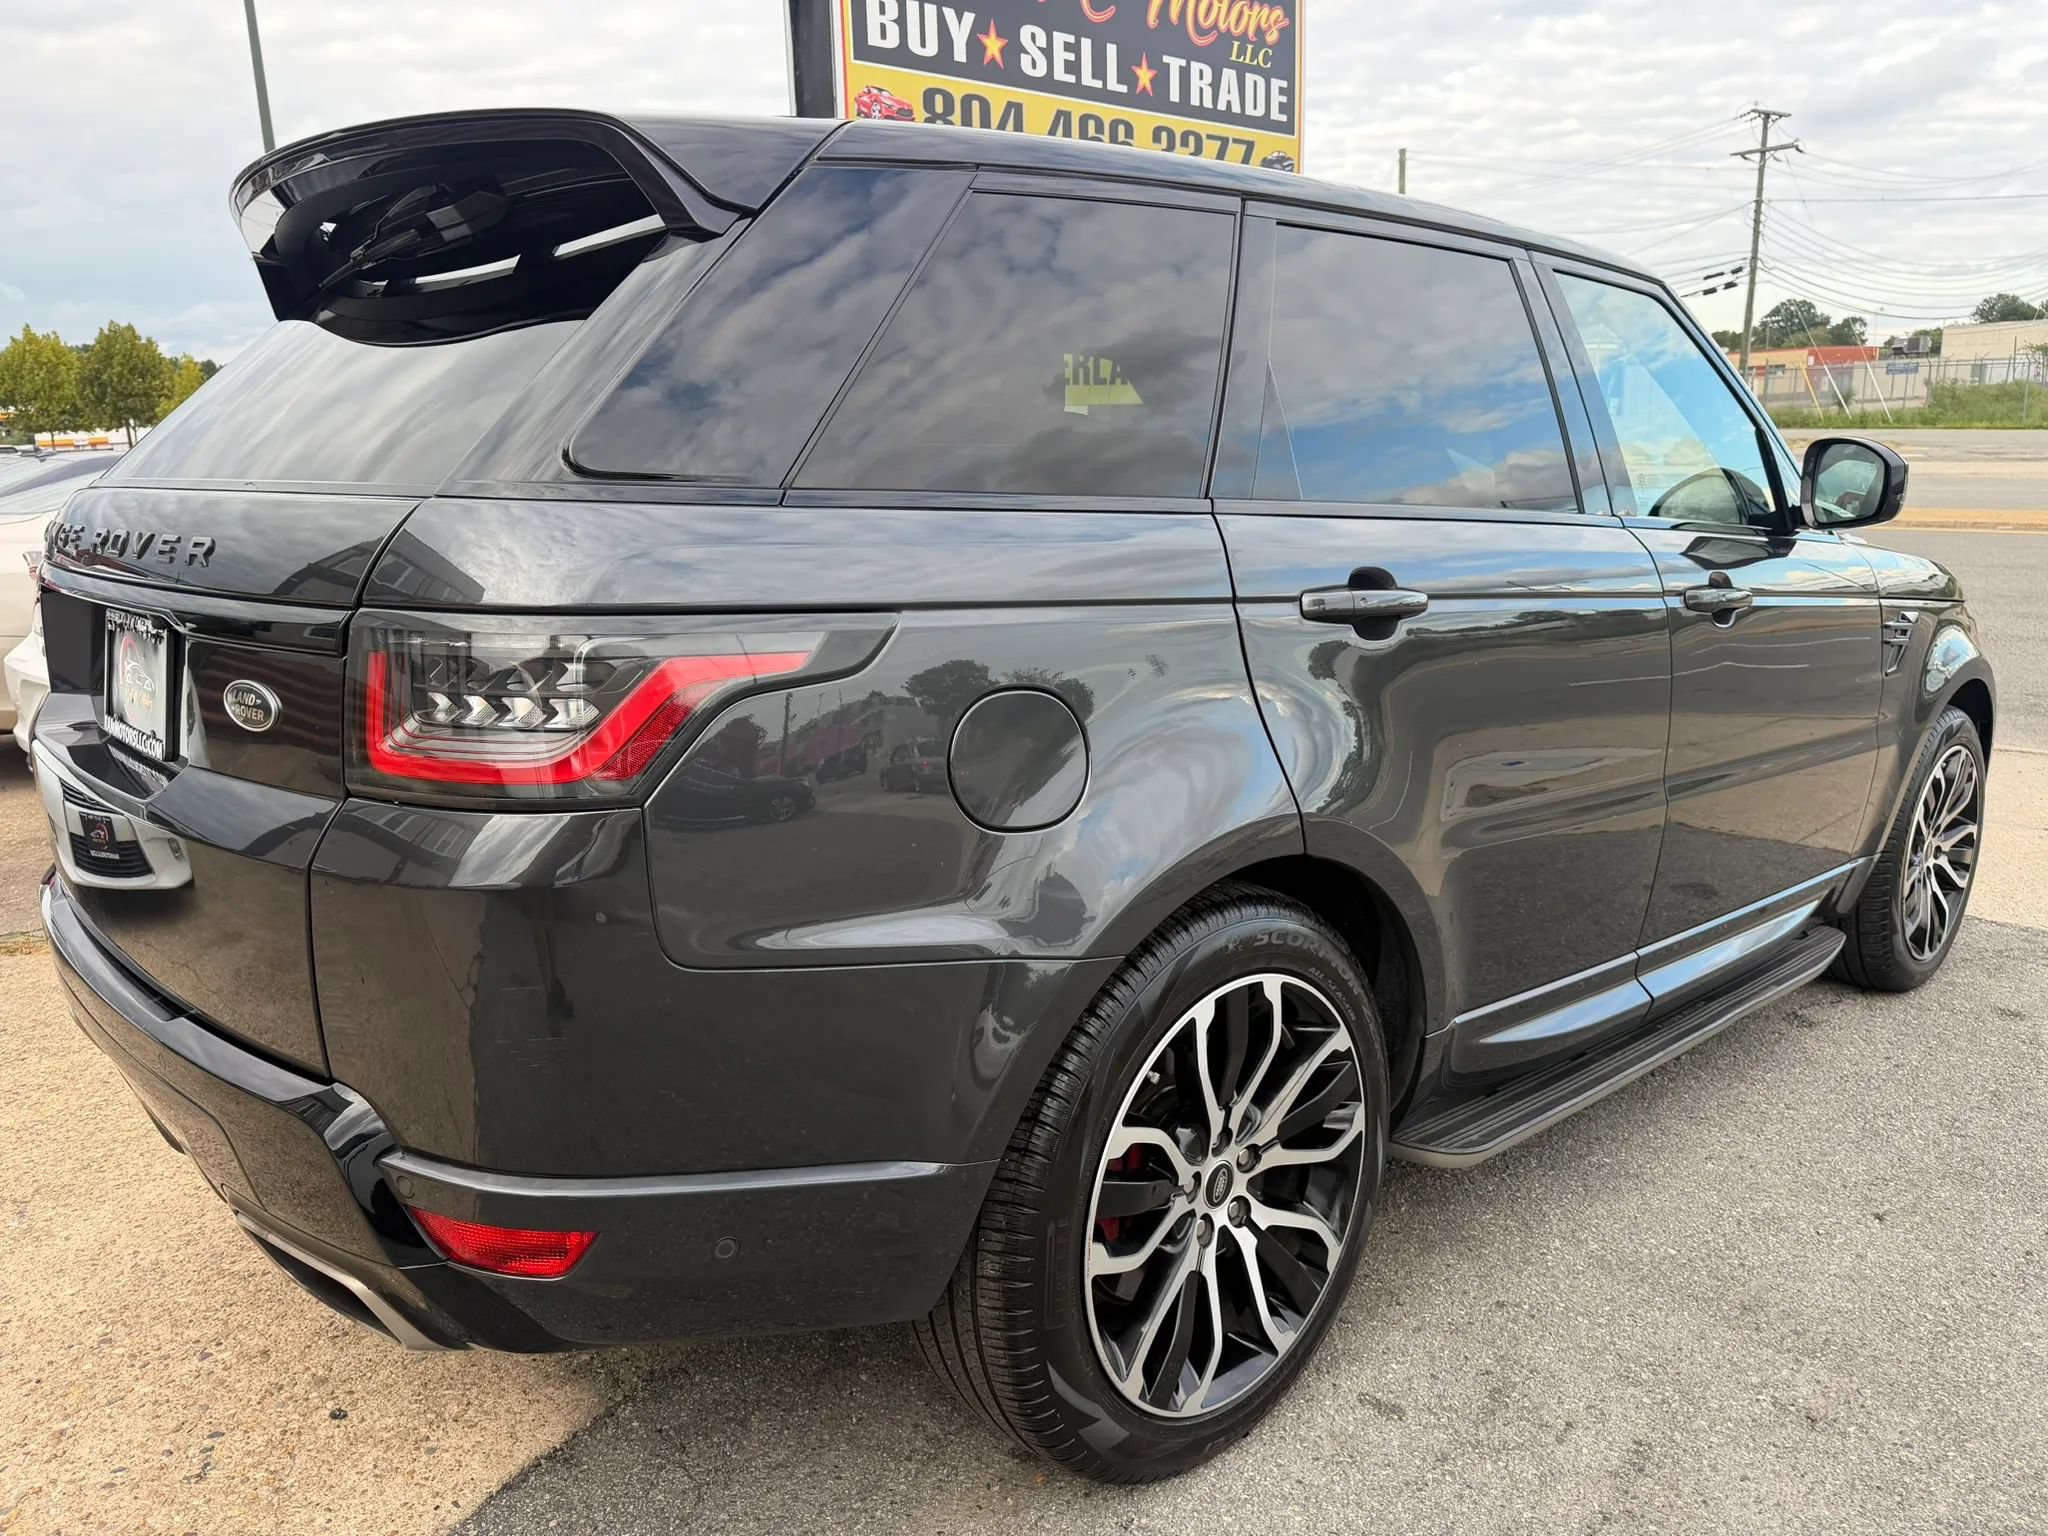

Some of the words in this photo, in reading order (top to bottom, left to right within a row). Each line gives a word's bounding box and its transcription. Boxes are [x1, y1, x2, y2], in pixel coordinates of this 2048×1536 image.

[866, 0, 976, 63] BUY
[1020, 24, 1128, 94] SELL
[1162, 54, 1288, 123] TRADE
[1229, 40, 1273, 69] LLC
[91, 527, 216, 568] ROVER
[233, 690, 256, 706] LAND
[234, 704, 264, 721] ROVER
[1253, 928, 1363, 996] SCORPION
